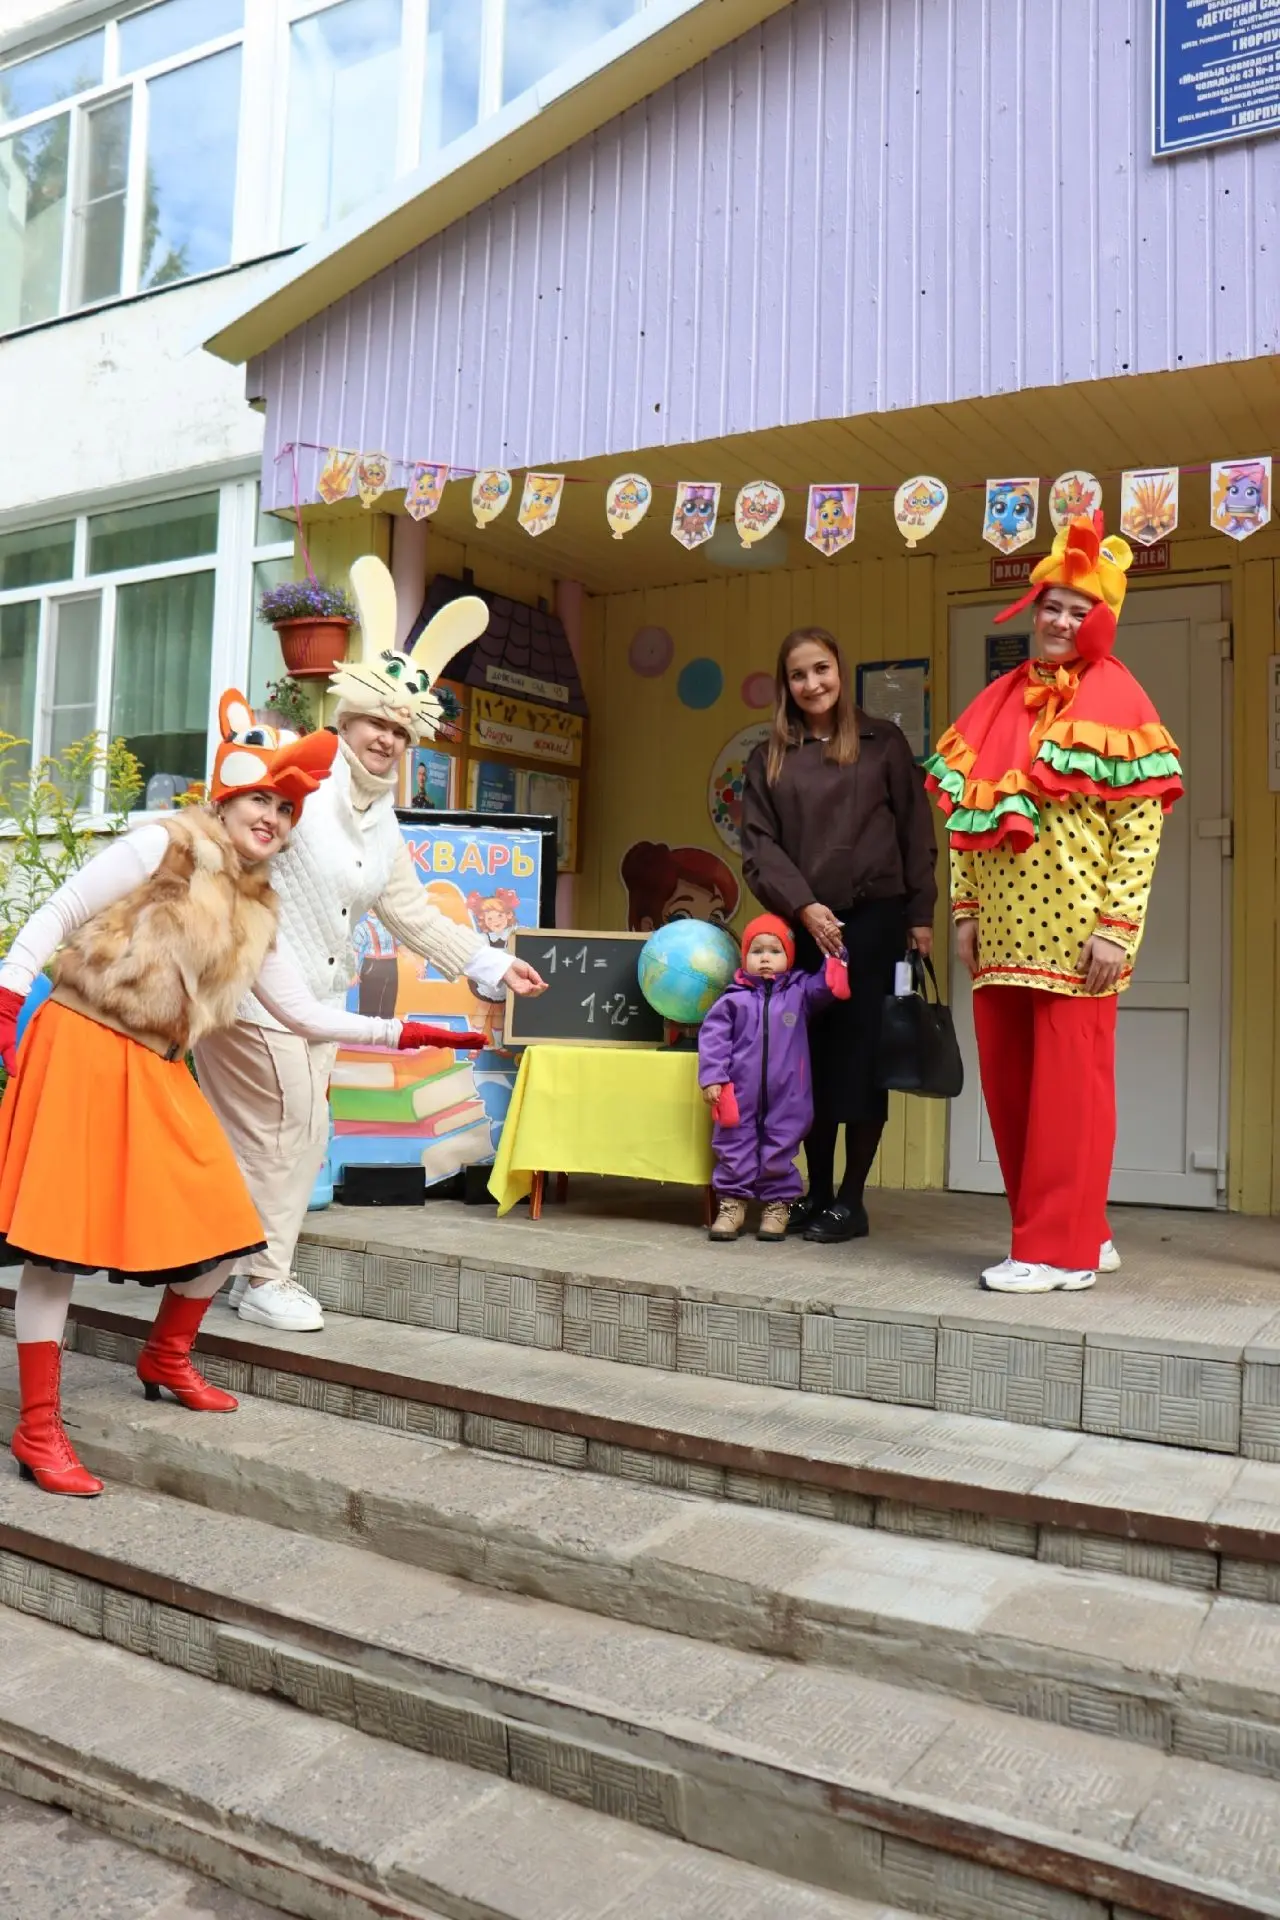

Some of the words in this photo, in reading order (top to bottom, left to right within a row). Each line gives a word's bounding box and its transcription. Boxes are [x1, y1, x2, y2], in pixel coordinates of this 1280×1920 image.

[996, 563, 1031, 579] ВХОД
[1133, 547, 1165, 566] ЕЛЕЙ
[406, 840, 535, 877] КВАРЬ
[541, 945, 608, 974] 1+1=
[580, 992, 639, 1026] 1+2=
